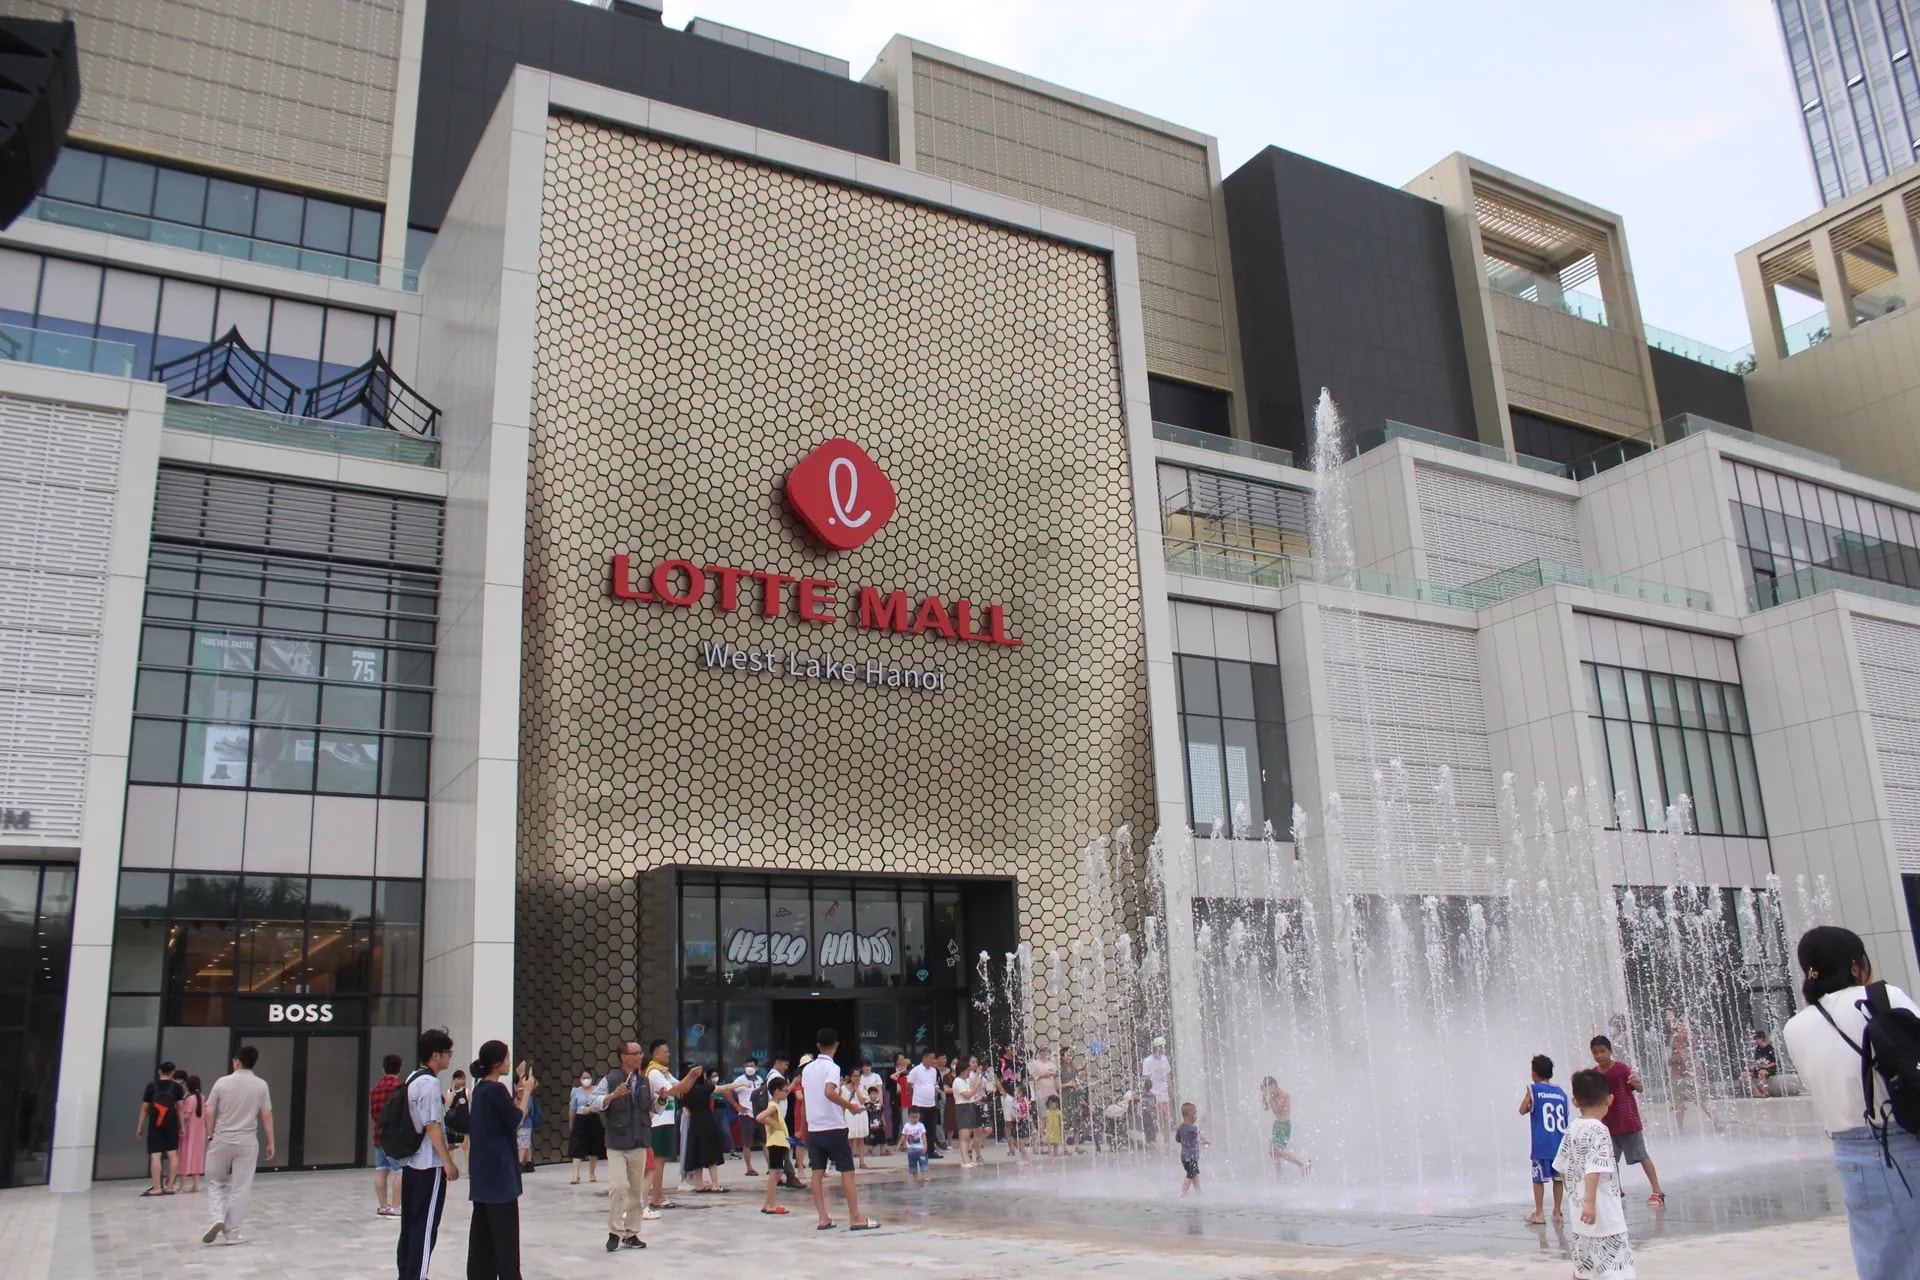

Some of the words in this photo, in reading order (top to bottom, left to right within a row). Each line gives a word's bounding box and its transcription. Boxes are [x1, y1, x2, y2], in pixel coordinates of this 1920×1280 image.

[613, 554, 837, 626] LOTTE
[859, 586, 1024, 648] MALL
[352, 659, 376, 682] 75
[702, 641, 777, 674] West
[789, 651, 856, 682] Lake
[865, 659, 946, 691] Hanoi
[727, 928, 809, 968] HELLO
[268, 1003, 334, 1023] BOSS
[1542, 1102, 1567, 1134] 68
